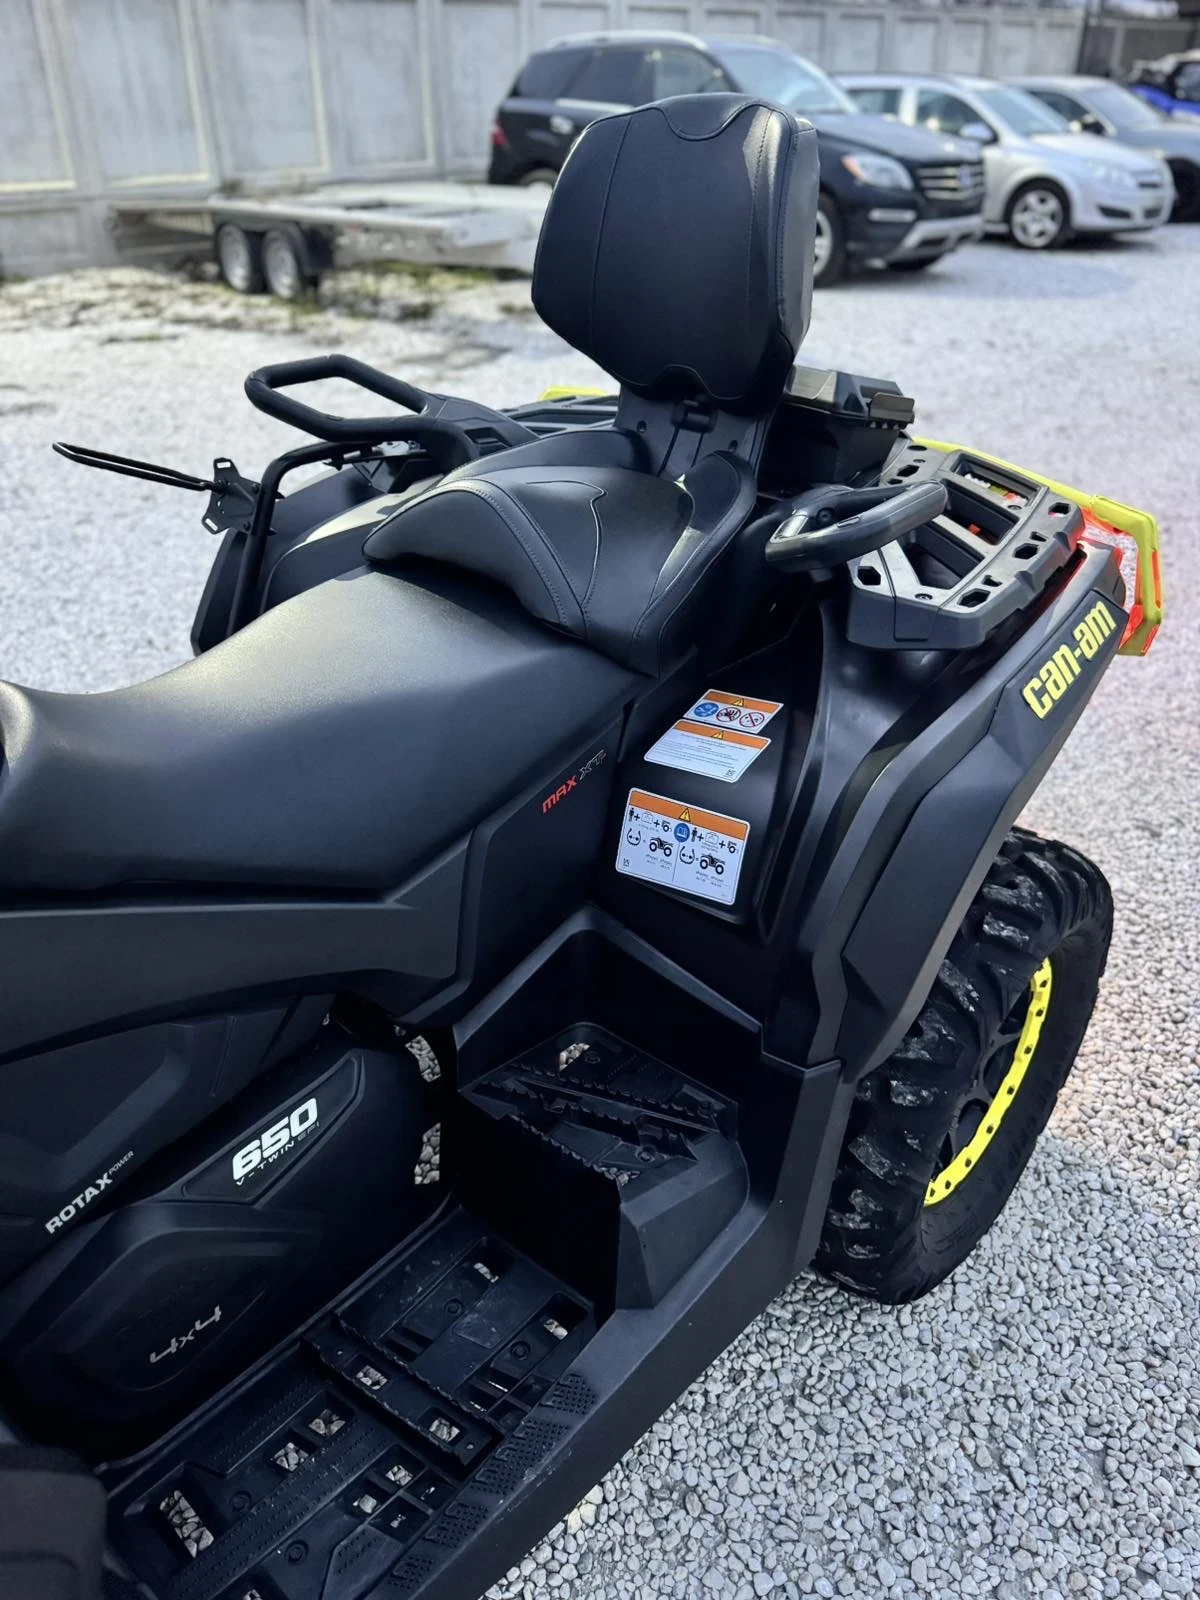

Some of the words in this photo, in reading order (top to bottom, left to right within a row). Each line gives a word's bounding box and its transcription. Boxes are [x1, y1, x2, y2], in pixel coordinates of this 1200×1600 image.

[542, 775, 577, 813] MAX
[232, 1097, 318, 1180] 650
[236, 1140, 295, 1186] V-TWIN
[45, 1172, 113, 1234] ROTAX
[108, 1150, 134, 1175] POWER
